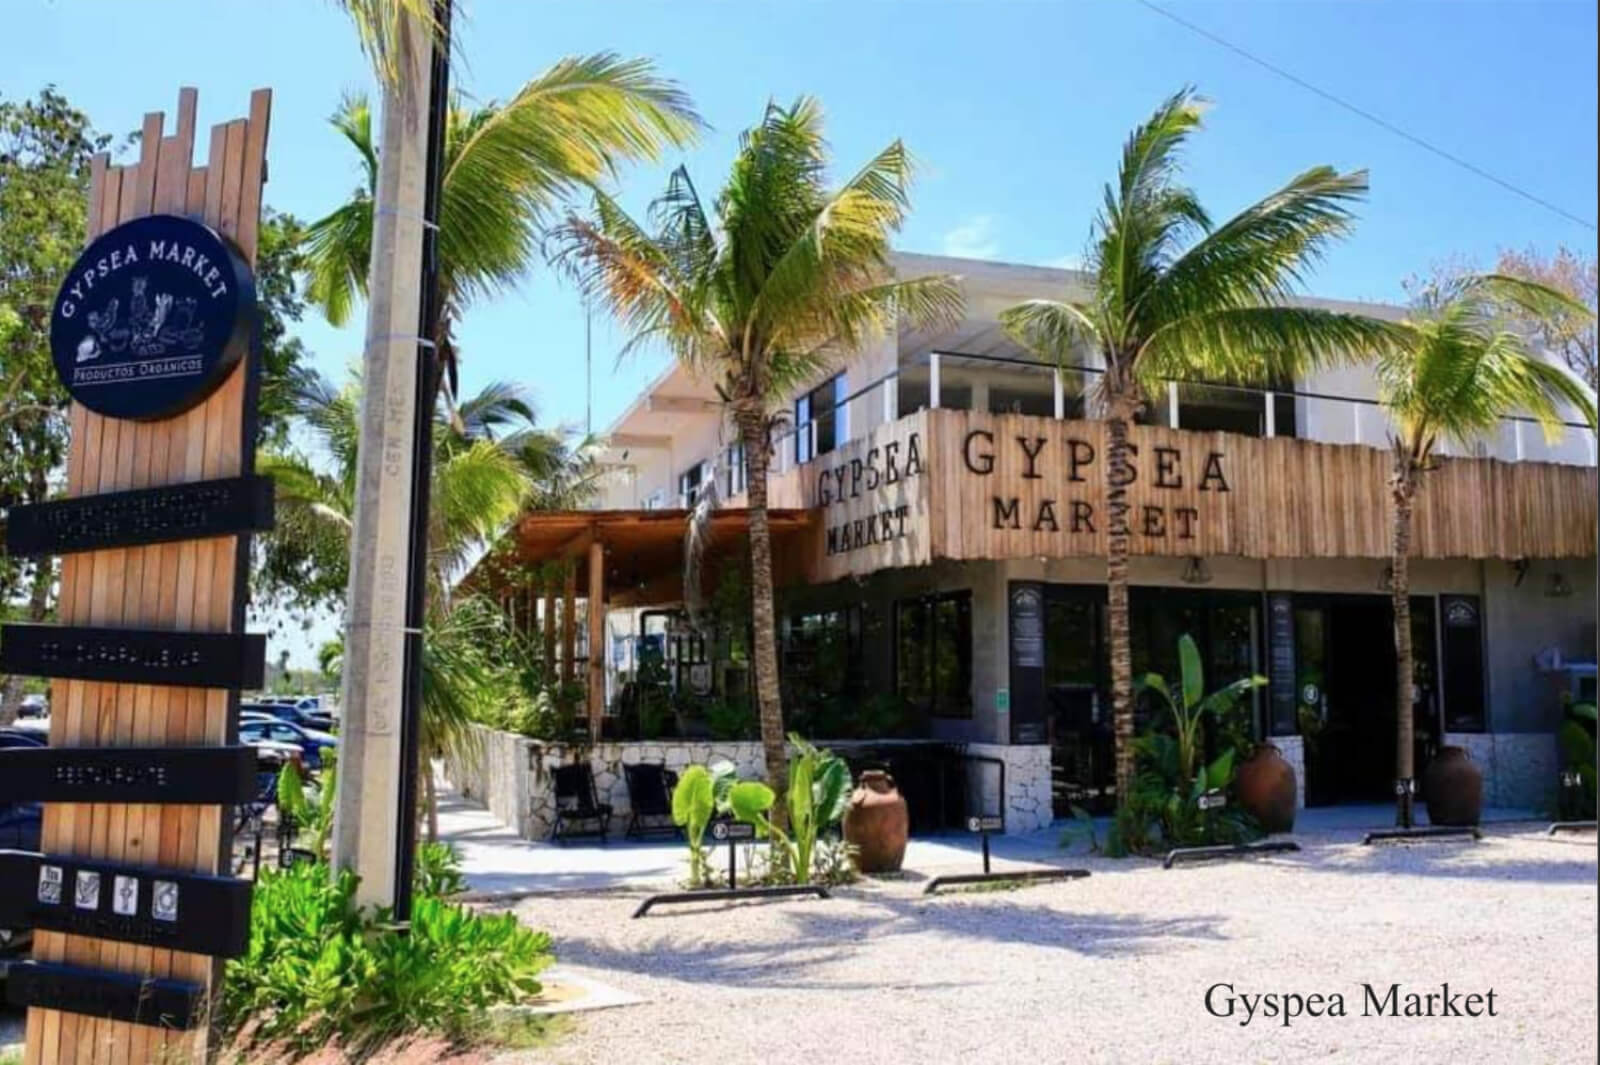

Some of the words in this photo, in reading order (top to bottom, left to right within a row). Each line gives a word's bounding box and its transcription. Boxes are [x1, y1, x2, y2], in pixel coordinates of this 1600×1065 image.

[61, 245, 138, 318] GYPSEA
[150, 240, 228, 299] MARKET
[818, 432, 926, 507] GYPSEA
[826, 505, 907, 556] MARKET
[992, 496, 1198, 539] MARET
